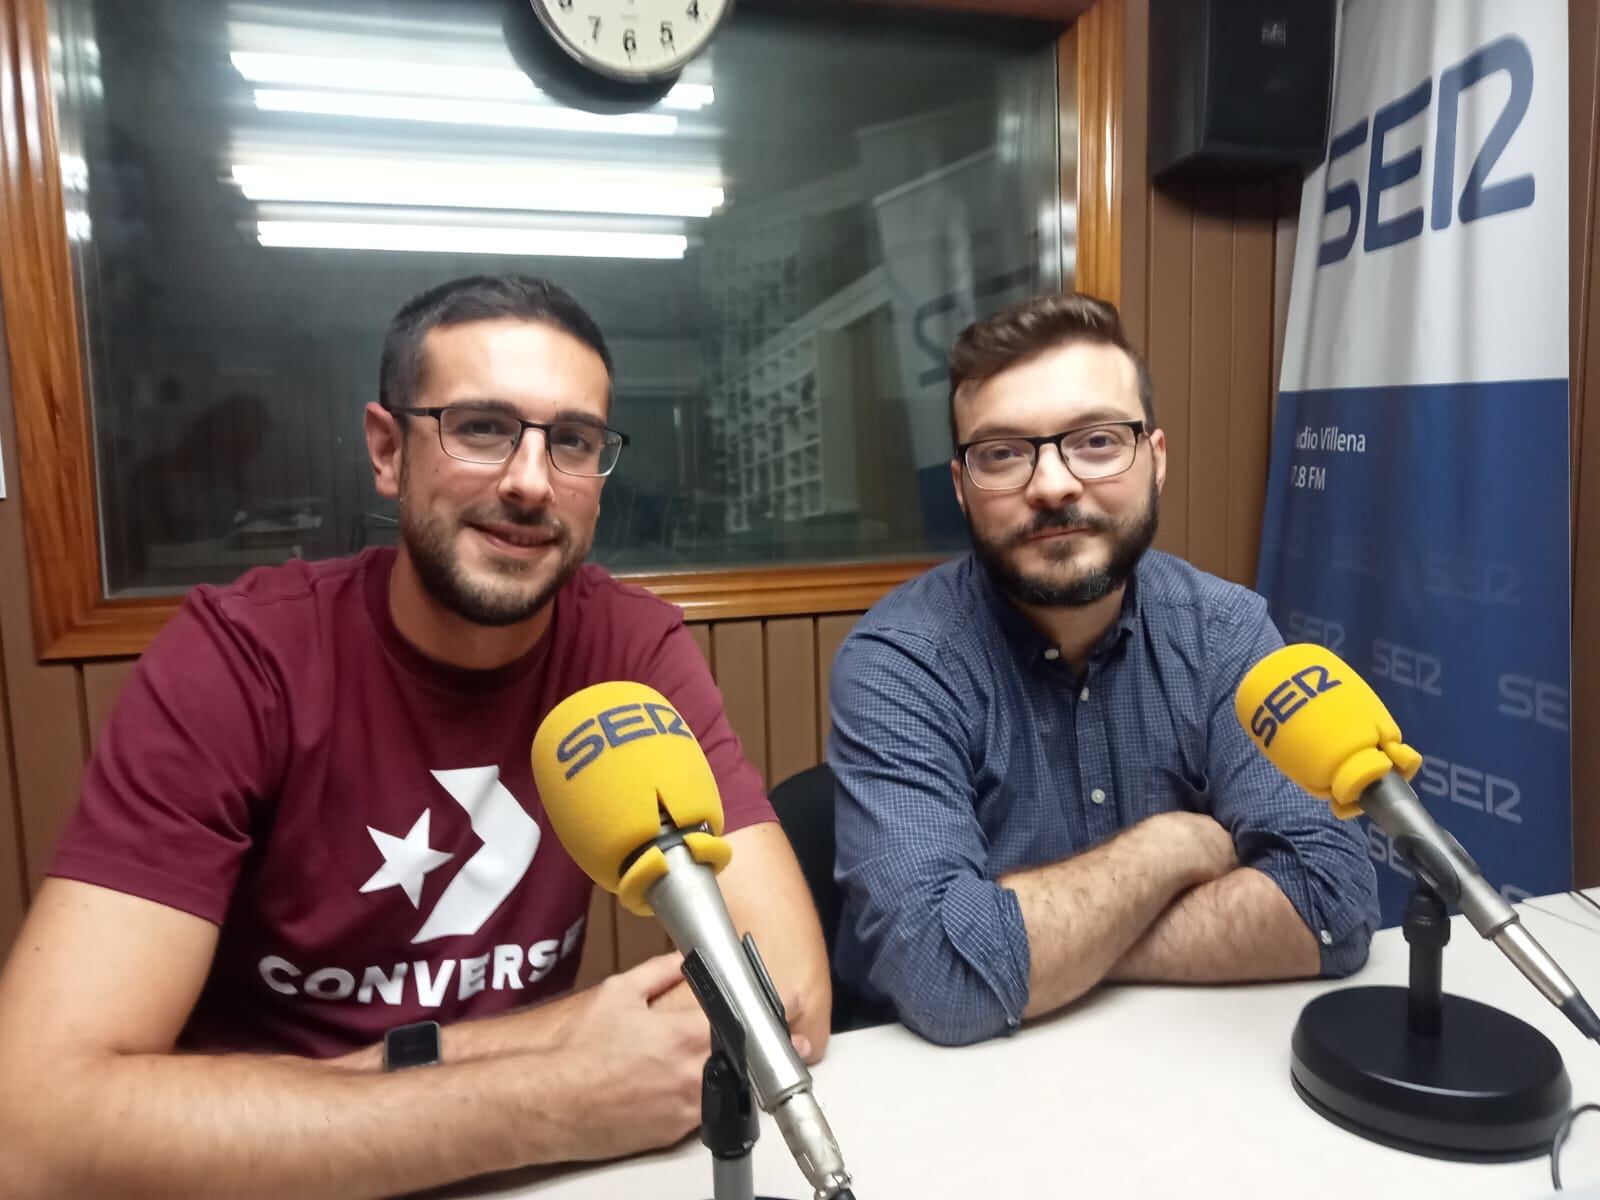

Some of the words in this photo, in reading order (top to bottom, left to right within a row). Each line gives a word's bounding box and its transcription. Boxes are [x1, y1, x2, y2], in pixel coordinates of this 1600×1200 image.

[587, 15, 602, 41] 7
[622, 29, 637, 51] 6
[660, 21, 674, 45] 5
[1316, 32, 1536, 268] SER
[1320, 426, 1367, 453] Villena
[1308, 466, 1327, 491] FM
[1371, 637, 1444, 697] SER
[1251, 665, 1343, 750] SER
[556, 702, 693, 781] SER
[1420, 754, 1523, 825] SER
[1366, 821, 1417, 880] SE
